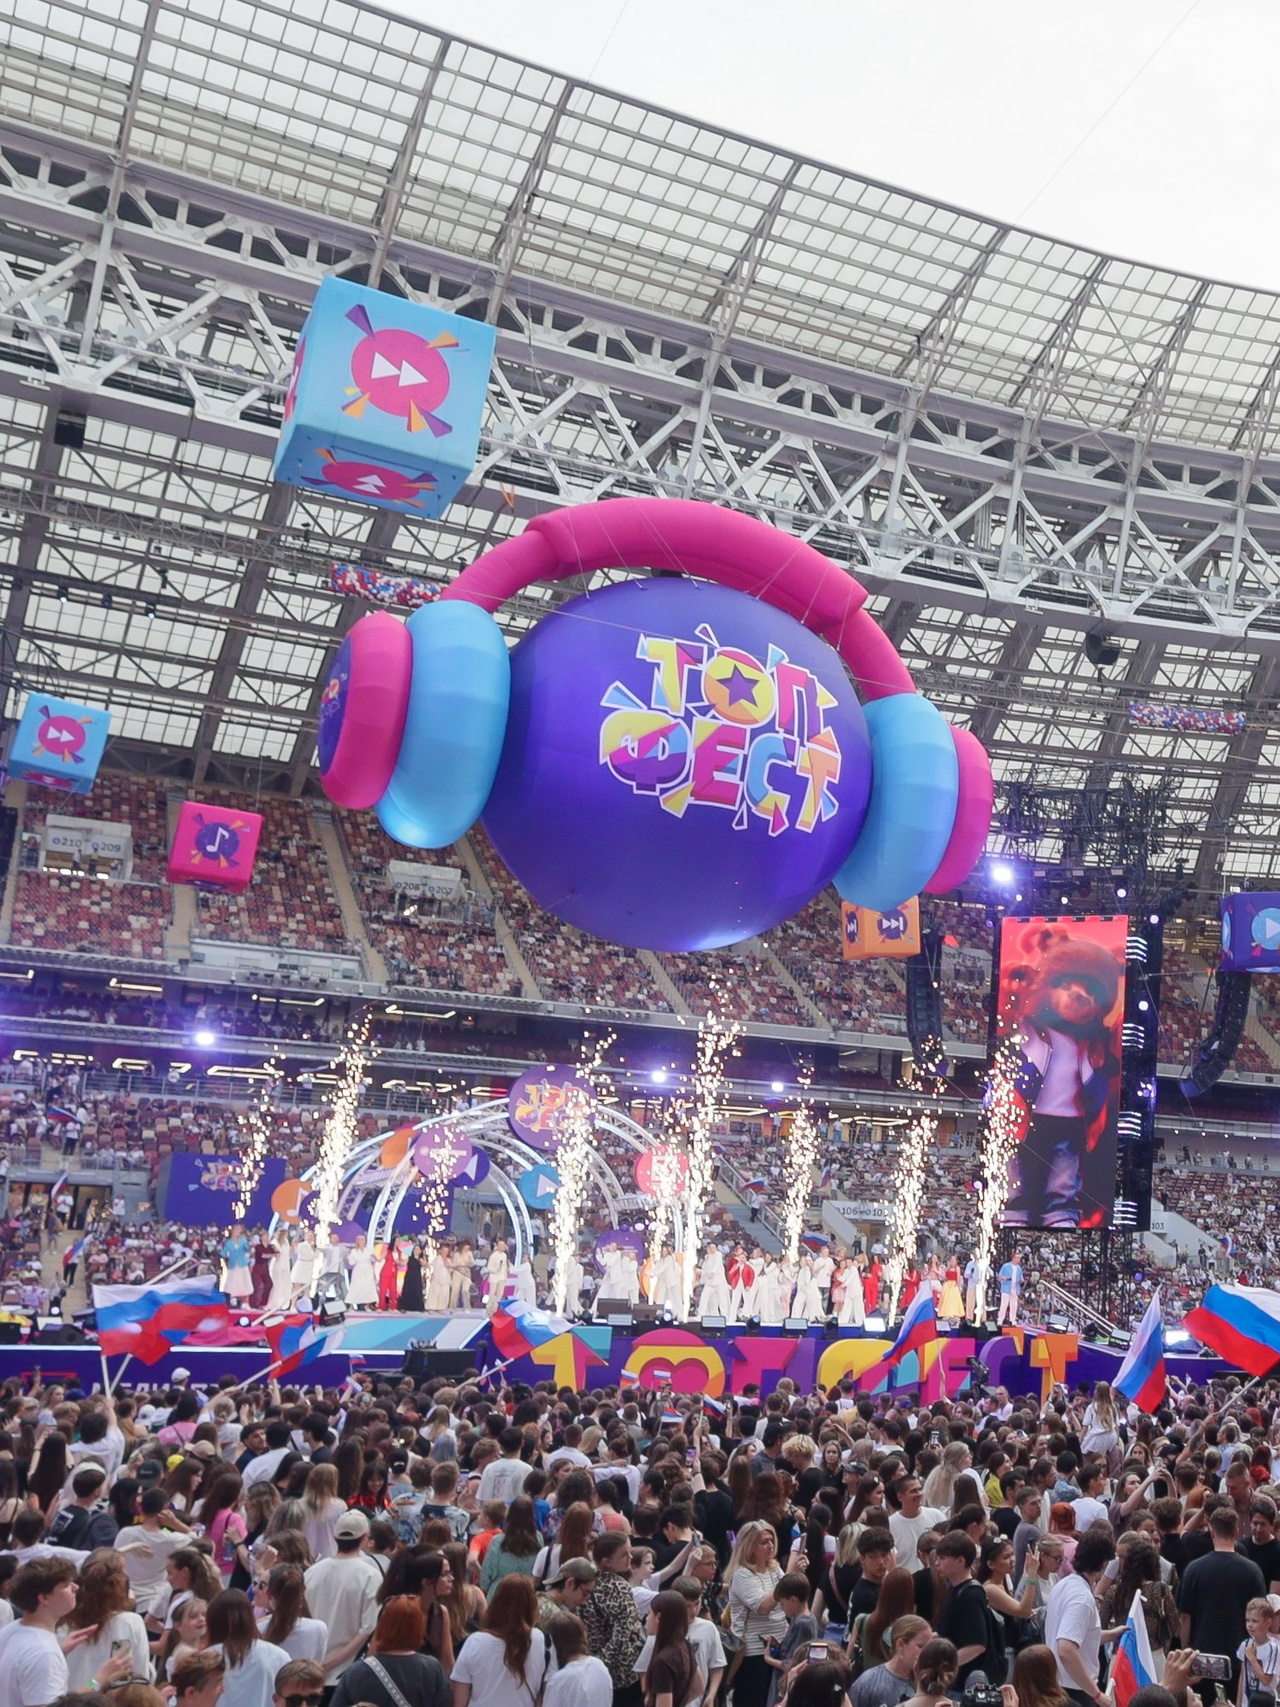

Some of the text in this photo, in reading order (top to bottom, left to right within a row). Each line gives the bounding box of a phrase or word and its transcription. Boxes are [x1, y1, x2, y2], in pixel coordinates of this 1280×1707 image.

[636, 637, 829, 746] ТОП
[600, 708, 842, 836] ФЕСТ
[61, 837, 82, 849] 210
[101, 842, 121, 852] 209
[437, 887, 453, 895] 207
[842, 1206, 858, 1215] 106
